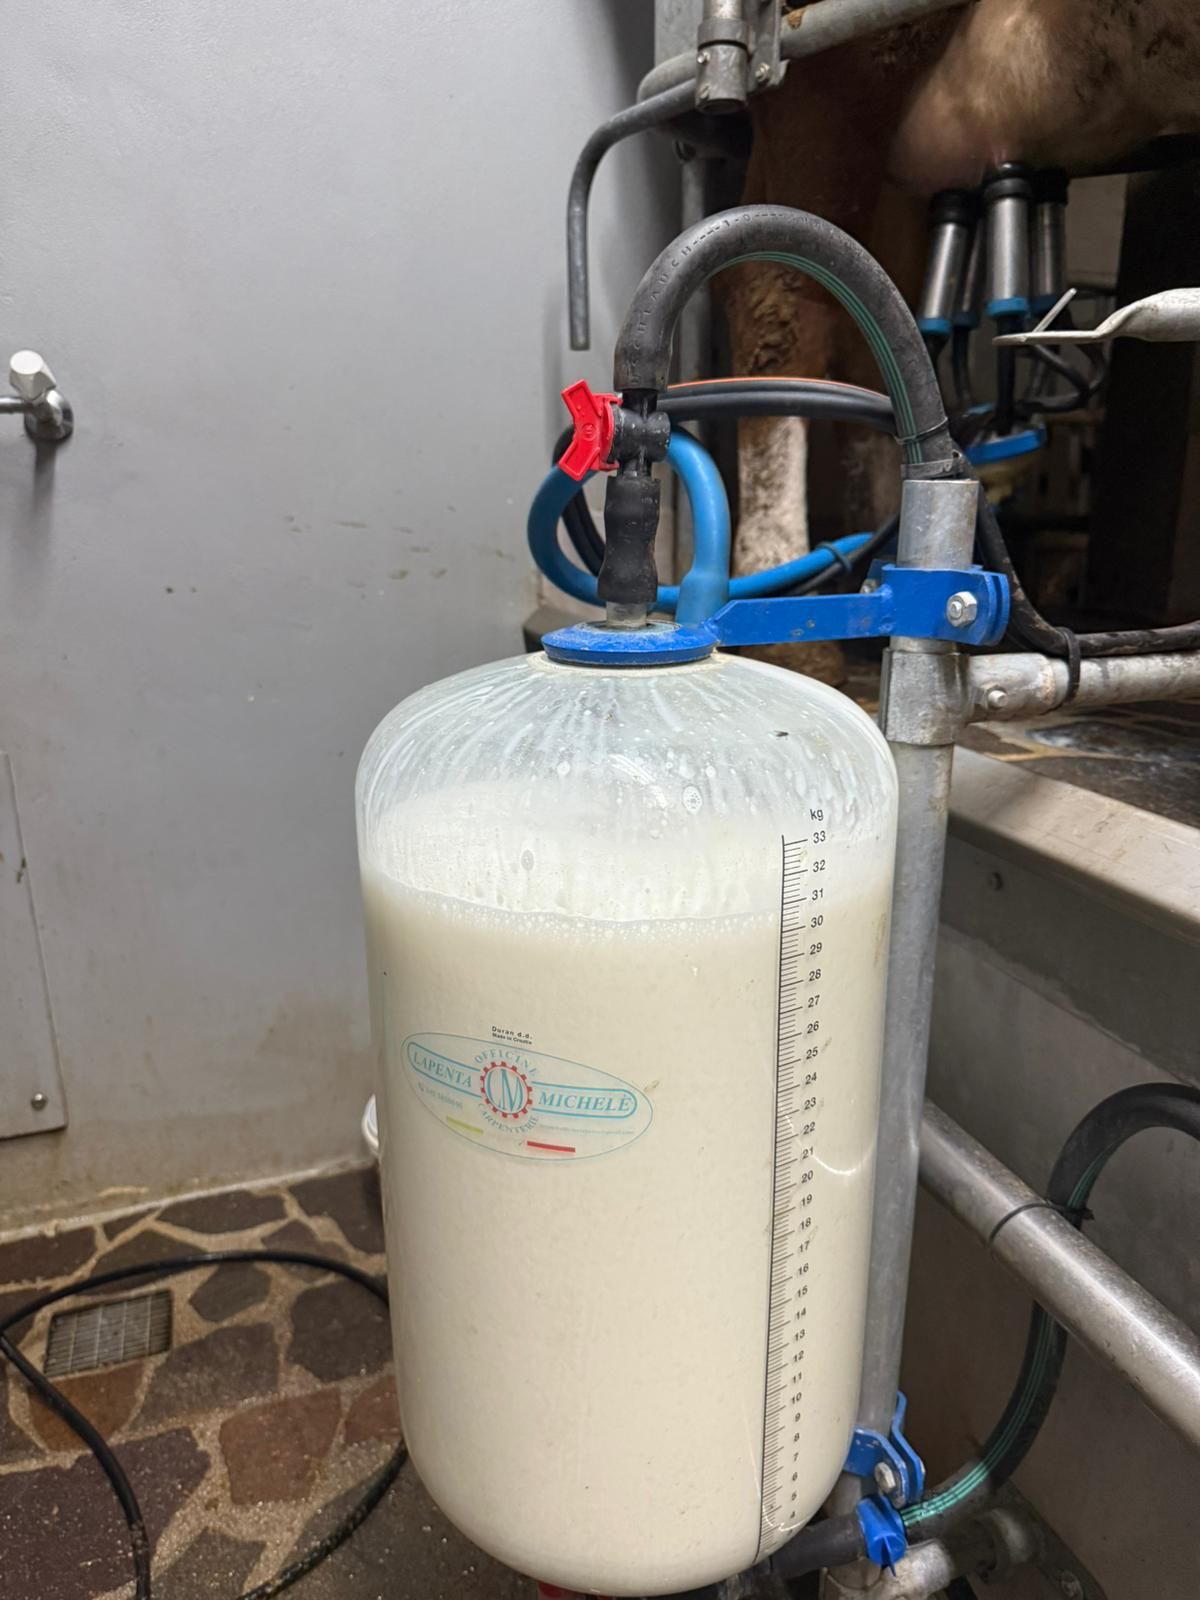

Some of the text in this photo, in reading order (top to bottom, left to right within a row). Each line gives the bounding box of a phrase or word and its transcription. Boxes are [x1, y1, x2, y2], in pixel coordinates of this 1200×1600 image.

[810, 808, 824, 821] kg
[813, 830, 826, 843] 33
[813, 860, 826, 872] 32
[812, 888, 824, 901] 31
[810, 915, 824, 928] 30
[810, 942, 822, 955] 29
[809, 968, 822, 982] 28
[808, 995, 820, 1009] 27
[807, 1020, 820, 1034] 26
[806, 1046, 818, 1060] 25
[412, 1051, 472, 1089] LAPENTA
[805, 1072, 817, 1086] 24
[537, 1090, 632, 1112] MICHELE
[804, 1097, 816, 1110] 23
[478, 1101, 540, 1133] CARPENTERIE
[803, 1122, 816, 1136] 22
[802, 1146, 814, 1160] 21
[801, 1170, 814, 1184] 20
[801, 1194, 813, 1207] 19
[800, 1217, 812, 1230] 18
[799, 1240, 810, 1254] 17
[798, 1263, 809, 1276] 16
[797, 1285, 808, 1299] 15
[796, 1307, 807, 1321] 14
[795, 1328, 806, 1342] 13
[793, 1350, 805, 1363] 12
[792, 1371, 802, 1384] 11
[791, 1392, 802, 1404] 10
